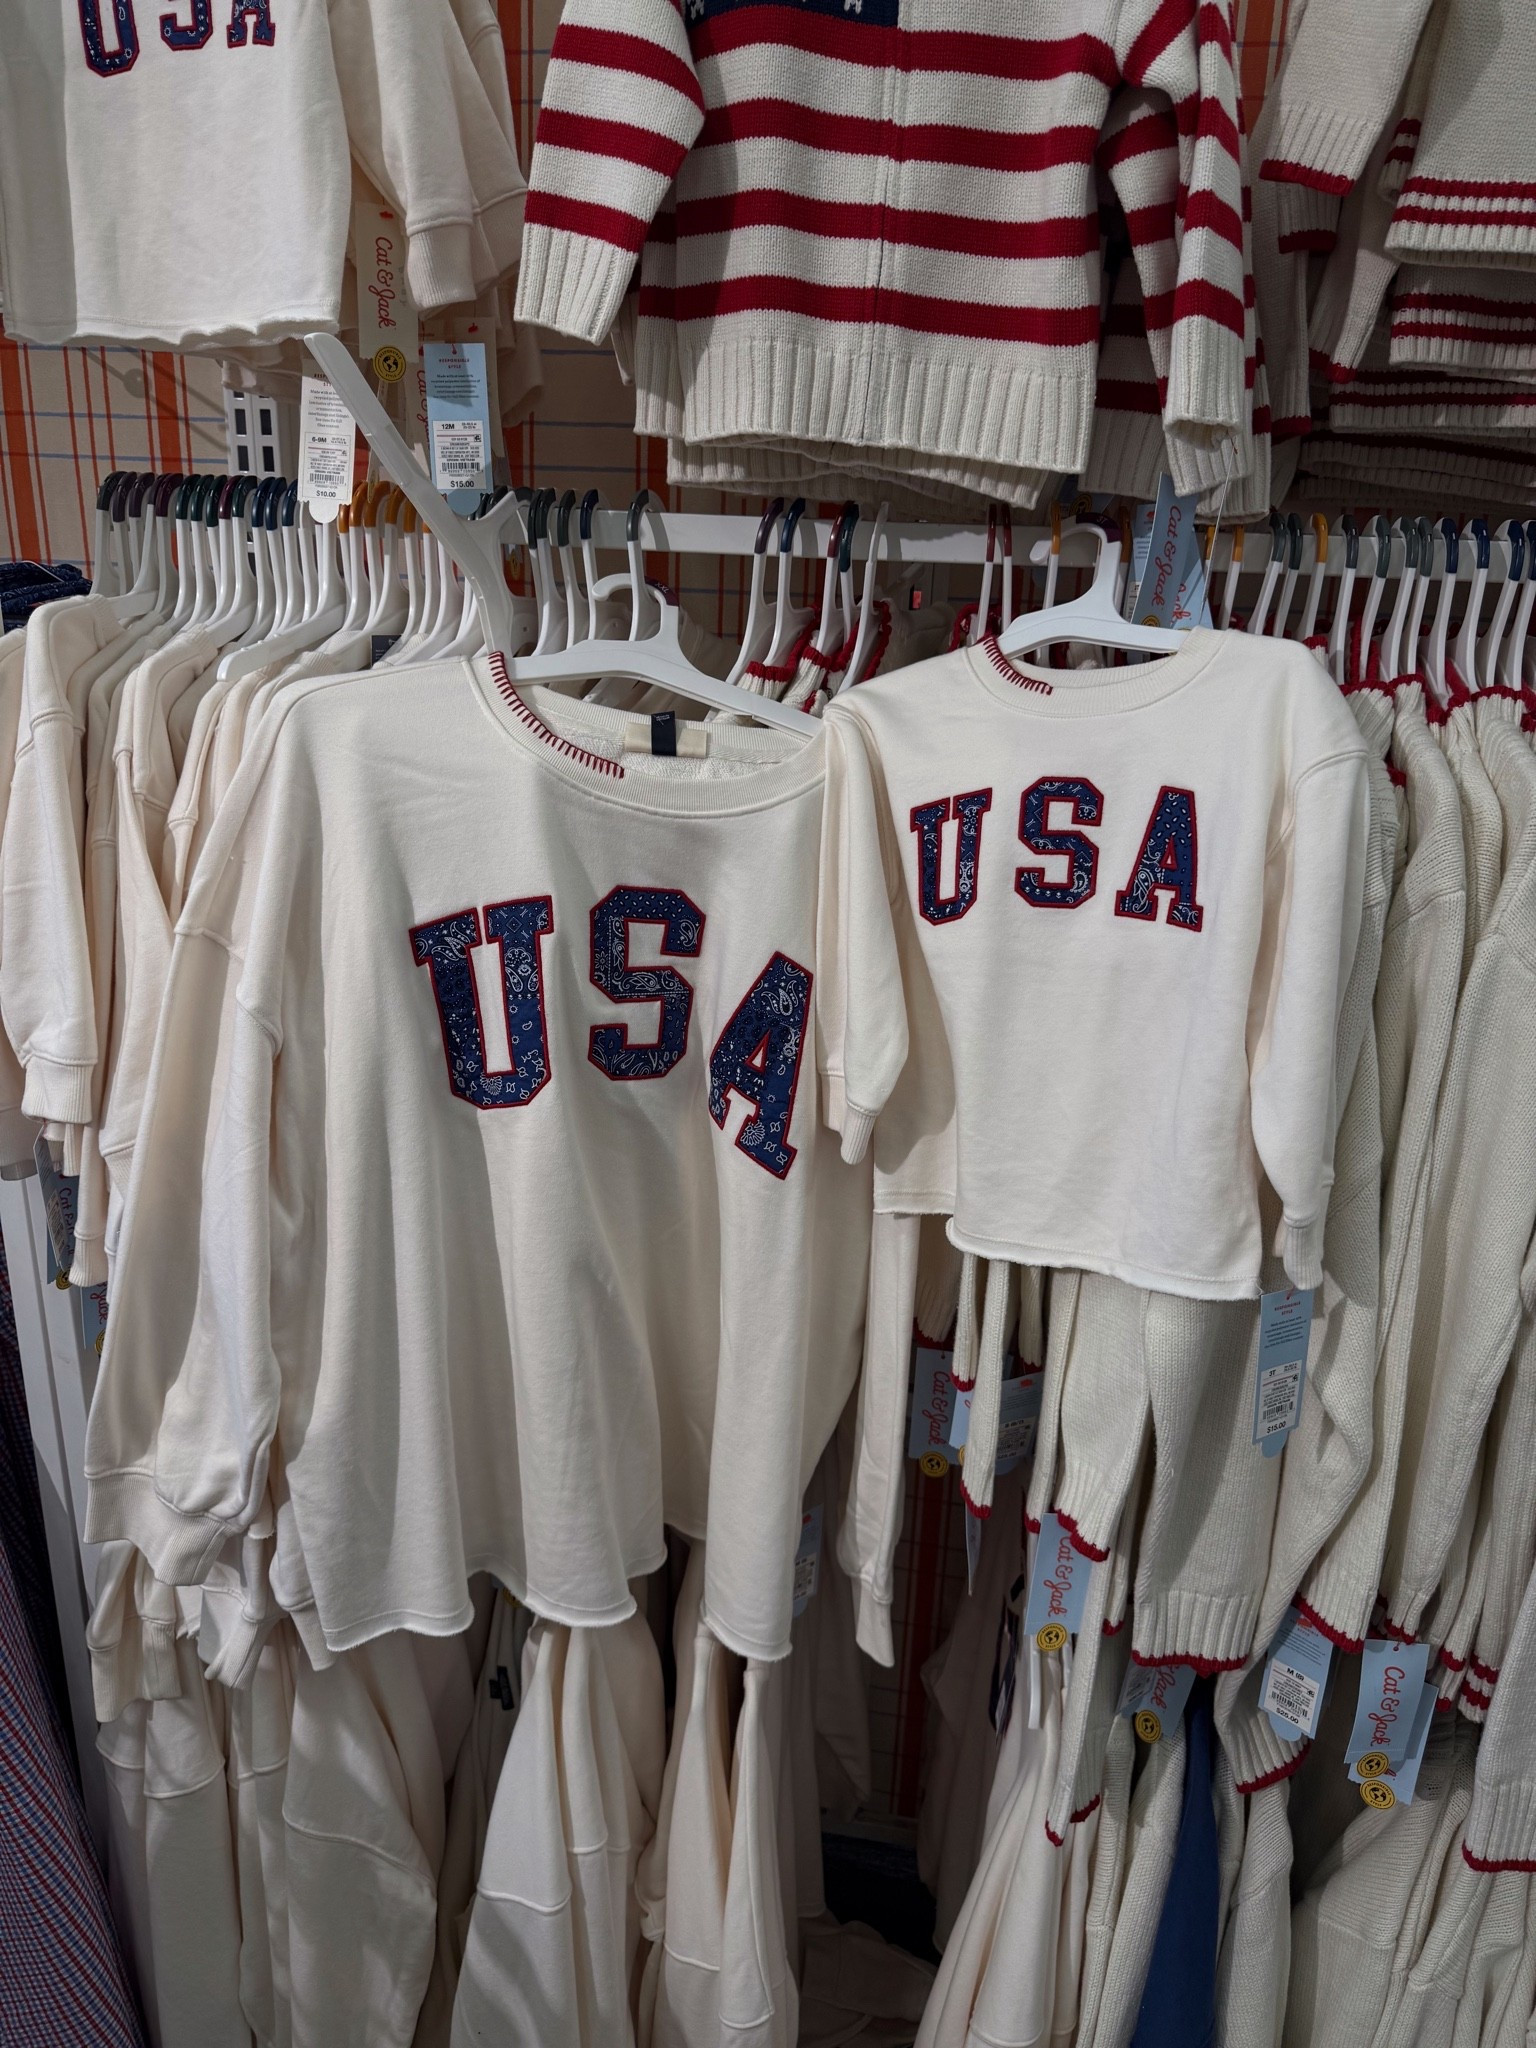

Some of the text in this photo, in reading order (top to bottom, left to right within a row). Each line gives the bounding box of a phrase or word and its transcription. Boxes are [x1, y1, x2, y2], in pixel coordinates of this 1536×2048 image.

[368, 236, 397, 329] Cat & Jack
[316, 490, 337, 498] $10.00
[450, 480, 475, 488] $15.00
[1151, 505, 1182, 606] Cat & Jack
[910, 776, 1204, 933] USA
[408, 885, 814, 1181] USA
[932, 1370, 951, 1396] Cat
[931, 1398, 949, 1414] &
[922, 1409, 949, 1446] Jack
[1266, 1420, 1287, 1434] $15.00
[1043, 1535, 1074, 1618] Cat & Jack
[1286, 1667, 1295, 1677] M
[1383, 1666, 1406, 1695] Cat
[1275, 1707, 1299, 1724] $25.00
[1380, 1697, 1400, 1713] &
[1368, 1712, 1397, 1747] Jack
